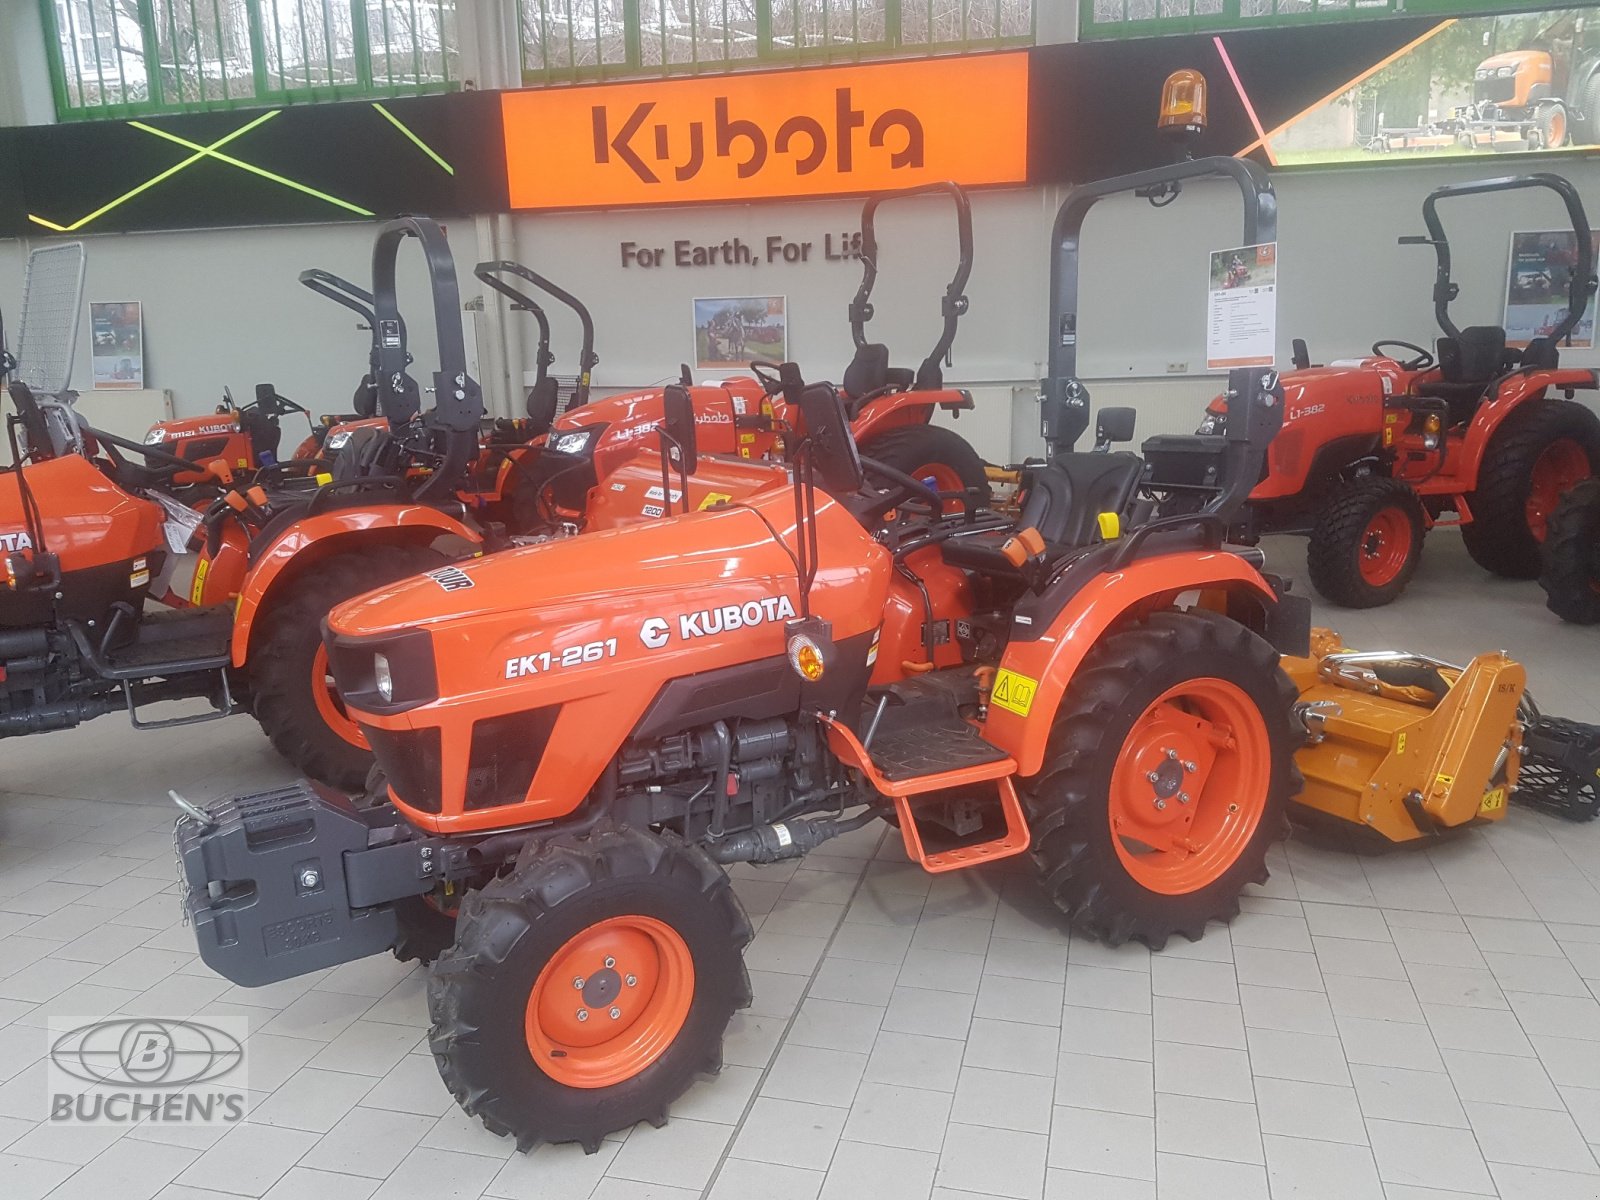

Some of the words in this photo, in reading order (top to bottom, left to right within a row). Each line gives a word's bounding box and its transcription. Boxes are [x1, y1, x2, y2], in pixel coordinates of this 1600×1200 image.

[592, 87, 924, 184] Kubota
[620, 241, 664, 268] For
[673, 237, 759, 266] Earth,
[766, 236, 812, 263] For
[824, 231, 877, 261] Lif
[694, 411, 733, 425] ubota
[1290, 403, 1326, 420] L1-382
[199, 423, 239, 434] KUBOT
[644, 505, 663, 517] 1200
[679, 595, 796, 641] KUBOTA
[505, 637, 617, 680] EK1-261
